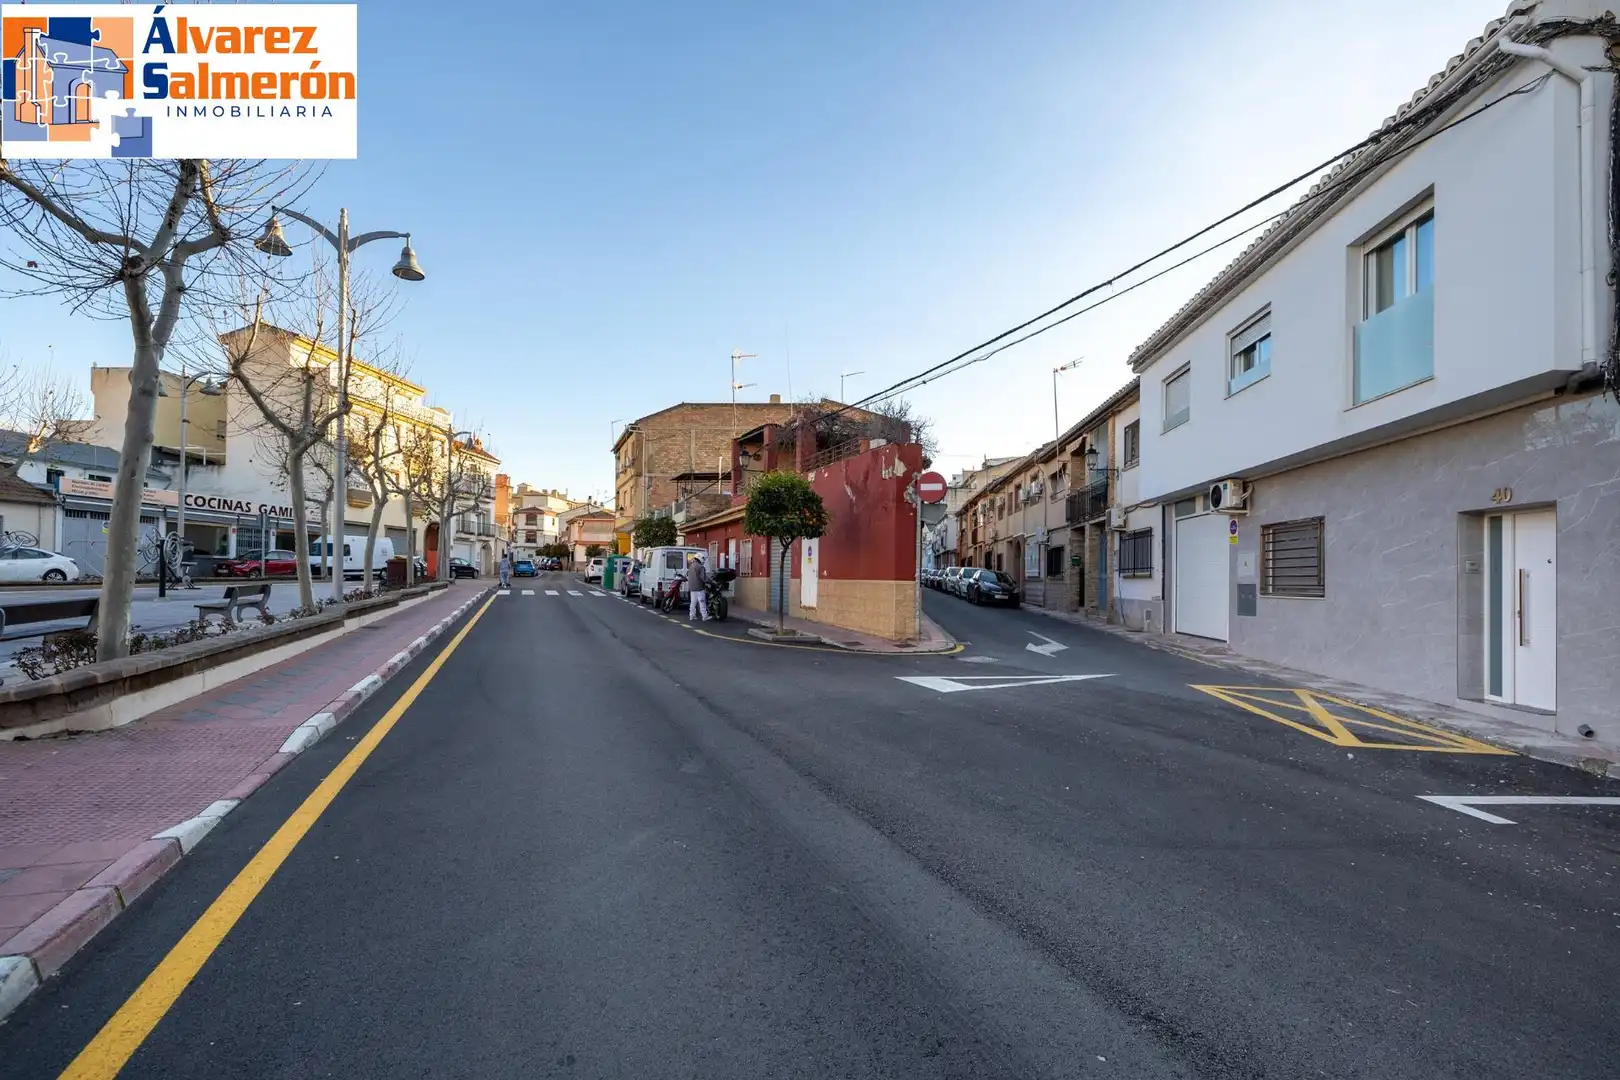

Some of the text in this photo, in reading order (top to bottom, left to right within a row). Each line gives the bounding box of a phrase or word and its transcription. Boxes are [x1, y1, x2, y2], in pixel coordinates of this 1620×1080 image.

[1492, 487, 1513, 503] 40
[184, 494, 252, 513] COCINAS
[259, 504, 294, 518] GAMI
